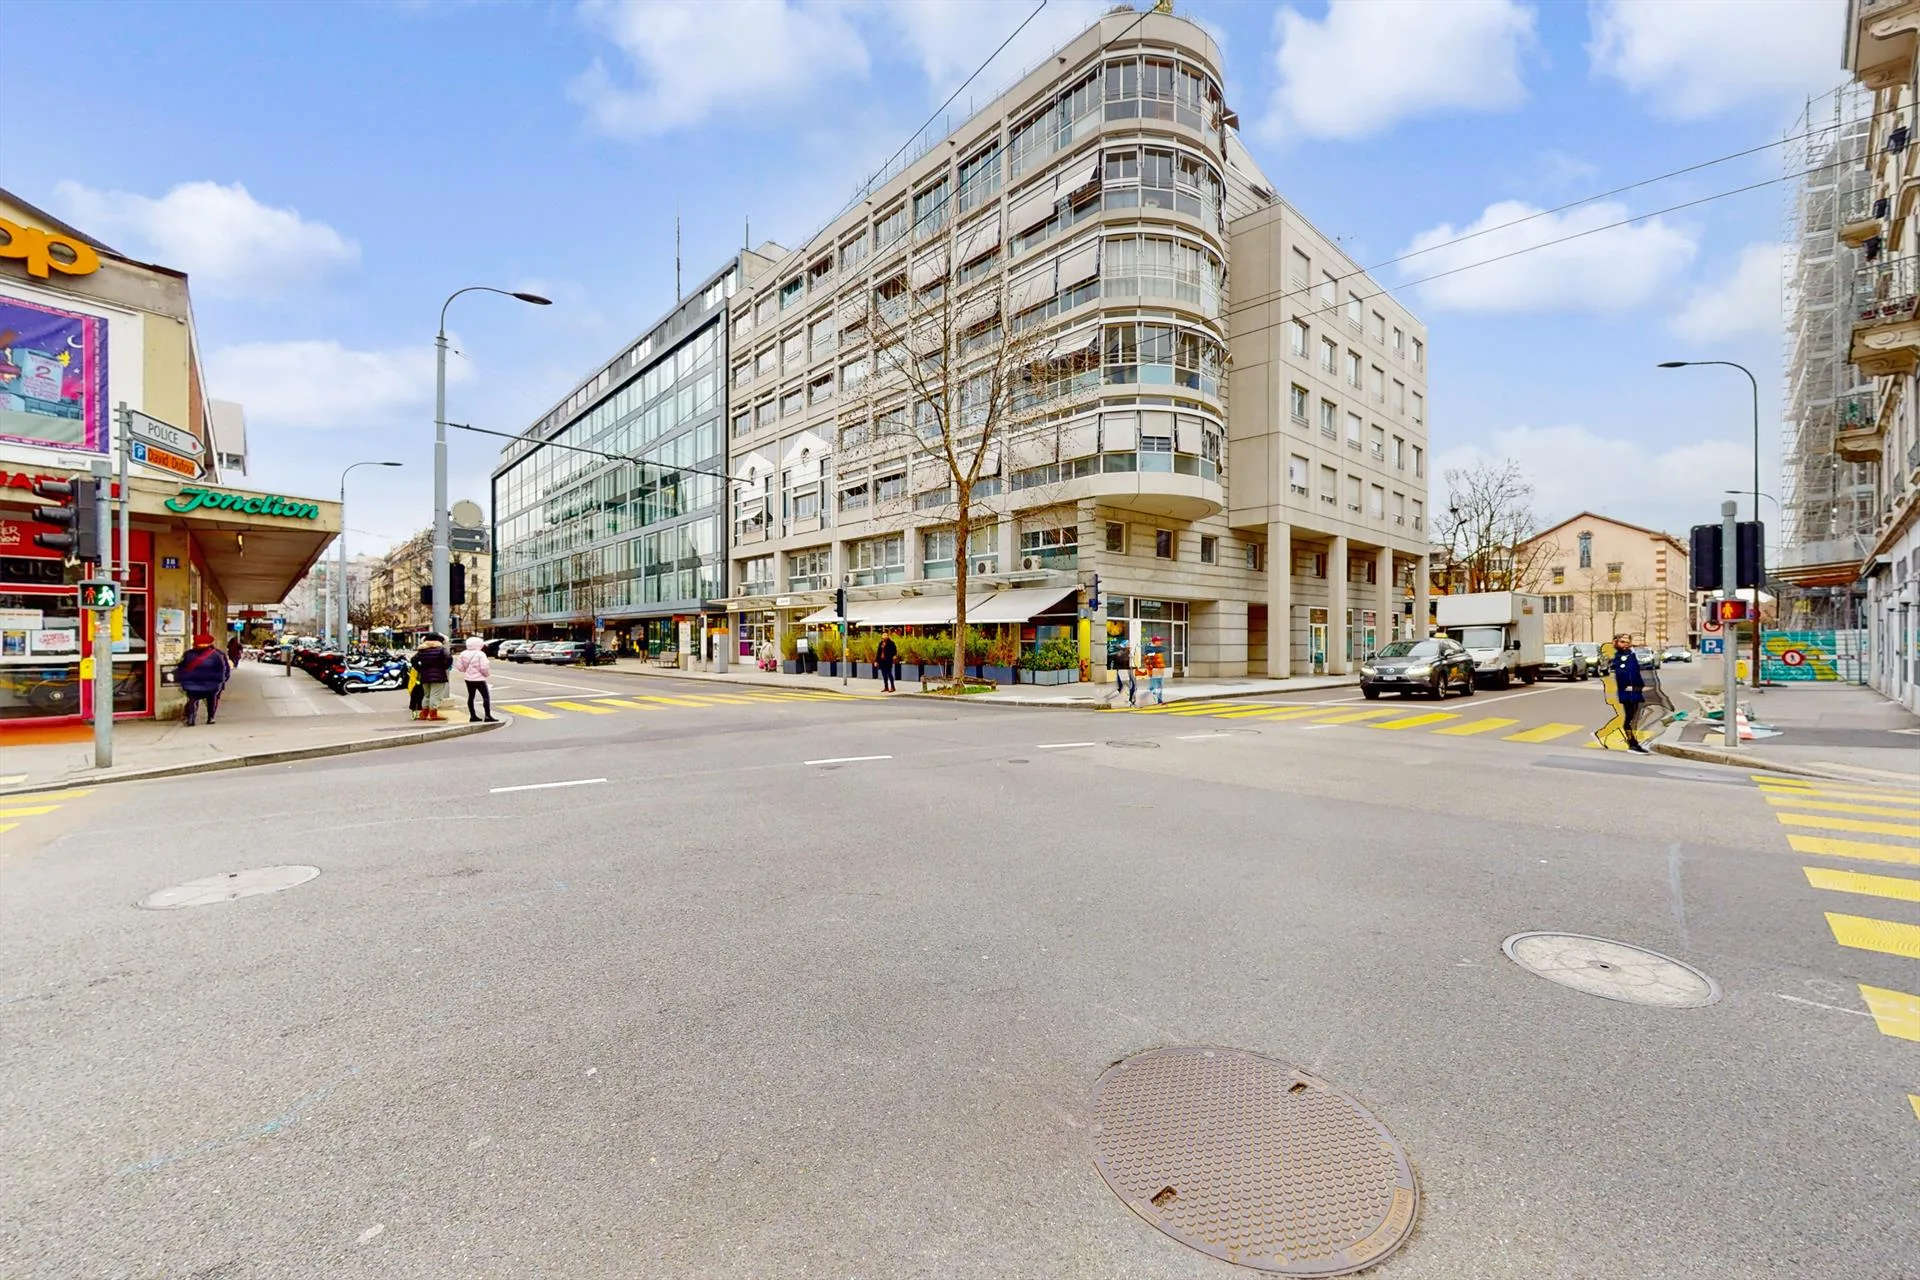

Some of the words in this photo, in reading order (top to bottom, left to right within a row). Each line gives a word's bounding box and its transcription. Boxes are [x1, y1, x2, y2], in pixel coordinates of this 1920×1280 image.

[35, 366, 55, 382] 2
[148, 422, 179, 445] POLICE
[137, 448, 144, 458] P
[148, 448, 168, 467] David
[164, 487, 319, 520] Jonction
[1705, 640, 1717, 652] P
